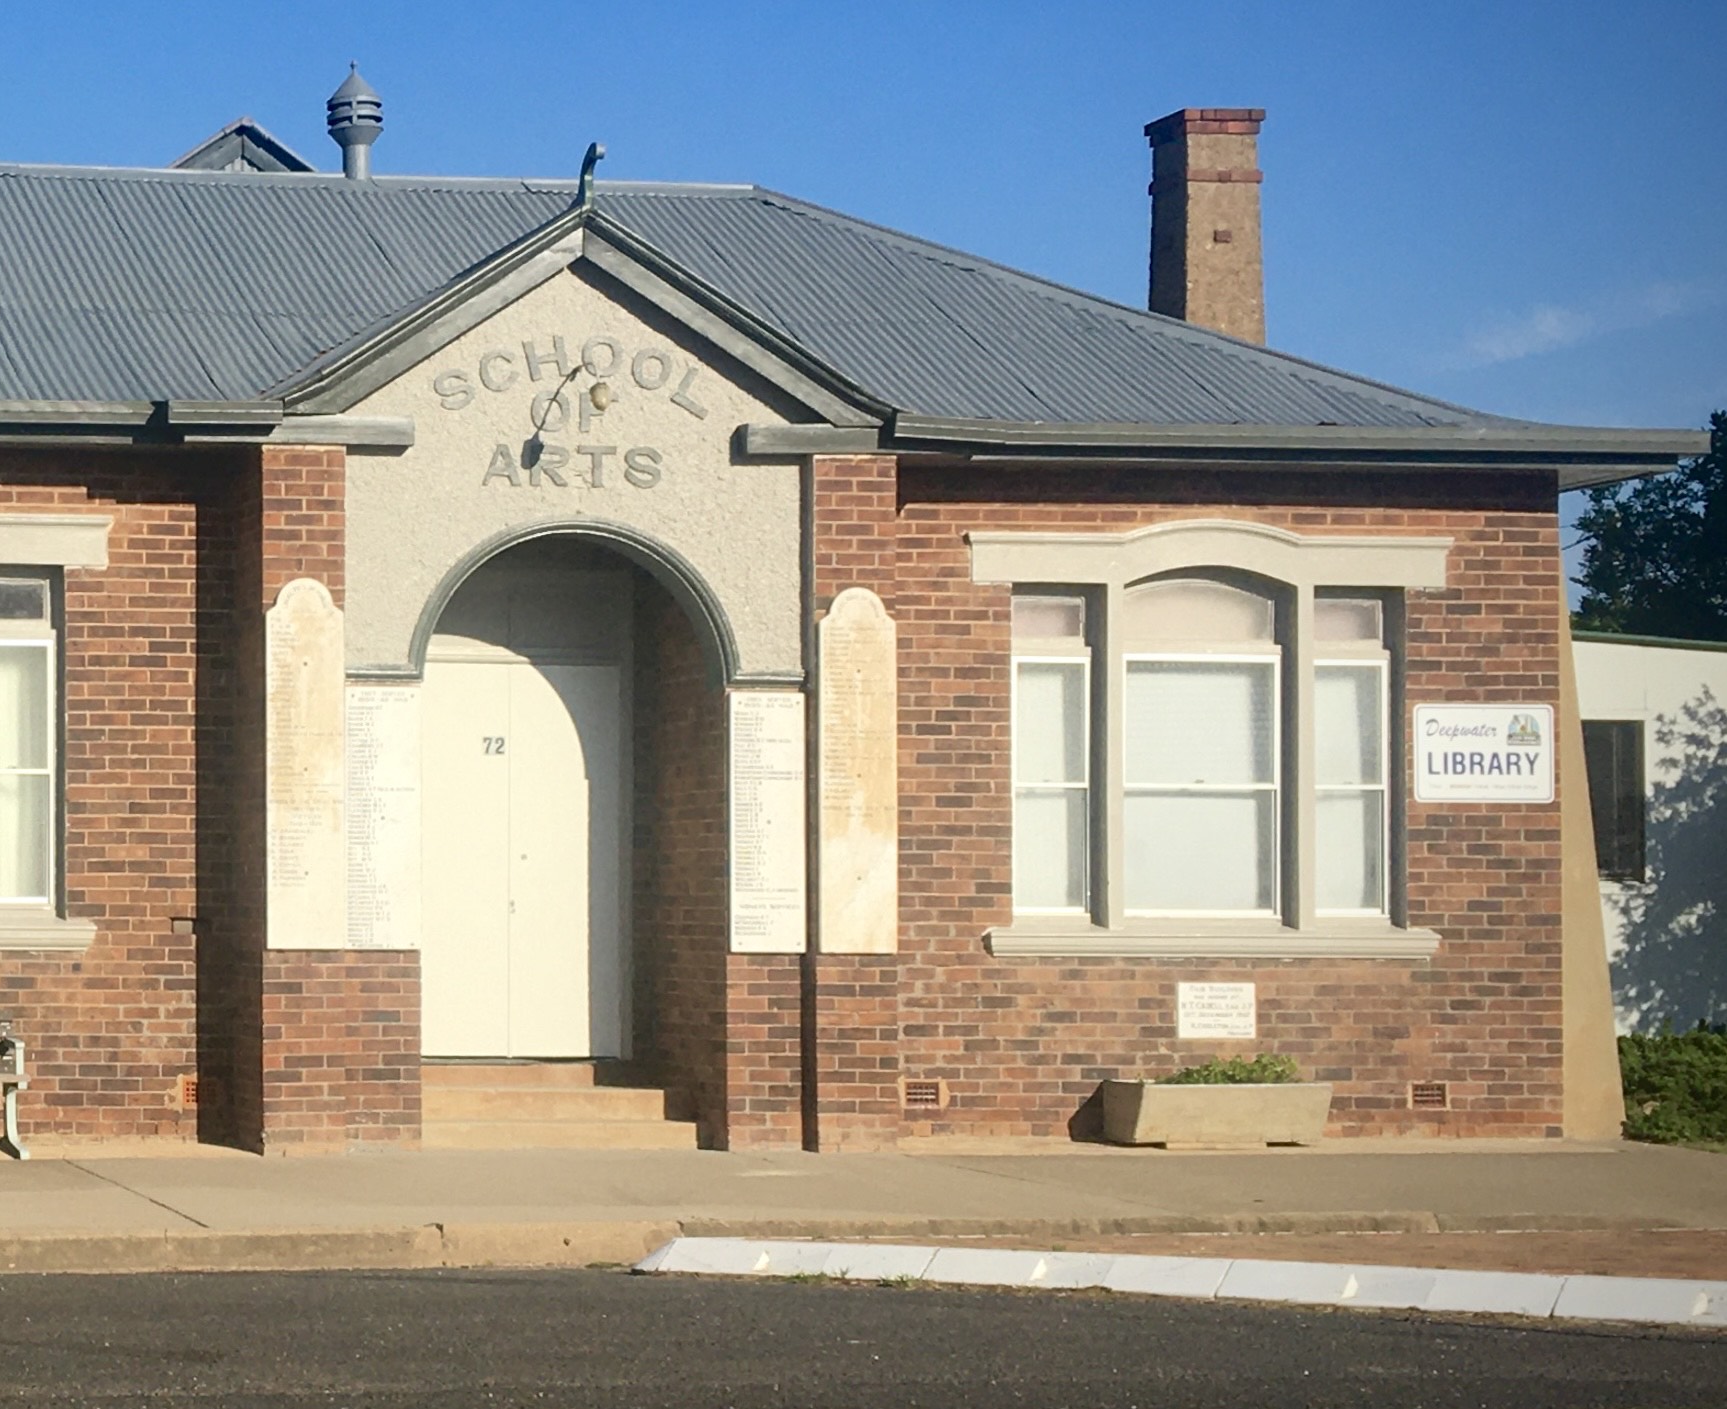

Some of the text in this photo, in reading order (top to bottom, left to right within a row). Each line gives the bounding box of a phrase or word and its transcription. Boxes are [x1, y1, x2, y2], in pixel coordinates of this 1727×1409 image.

[433, 335, 709, 421] SCHOOL
[530, 389, 620, 433] OF
[481, 443, 664, 490] ARTS
[483, 736, 505, 755] 72
[1425, 718, 1498, 741] Deepwater
[1427, 751, 1540, 776] LIBRARY
